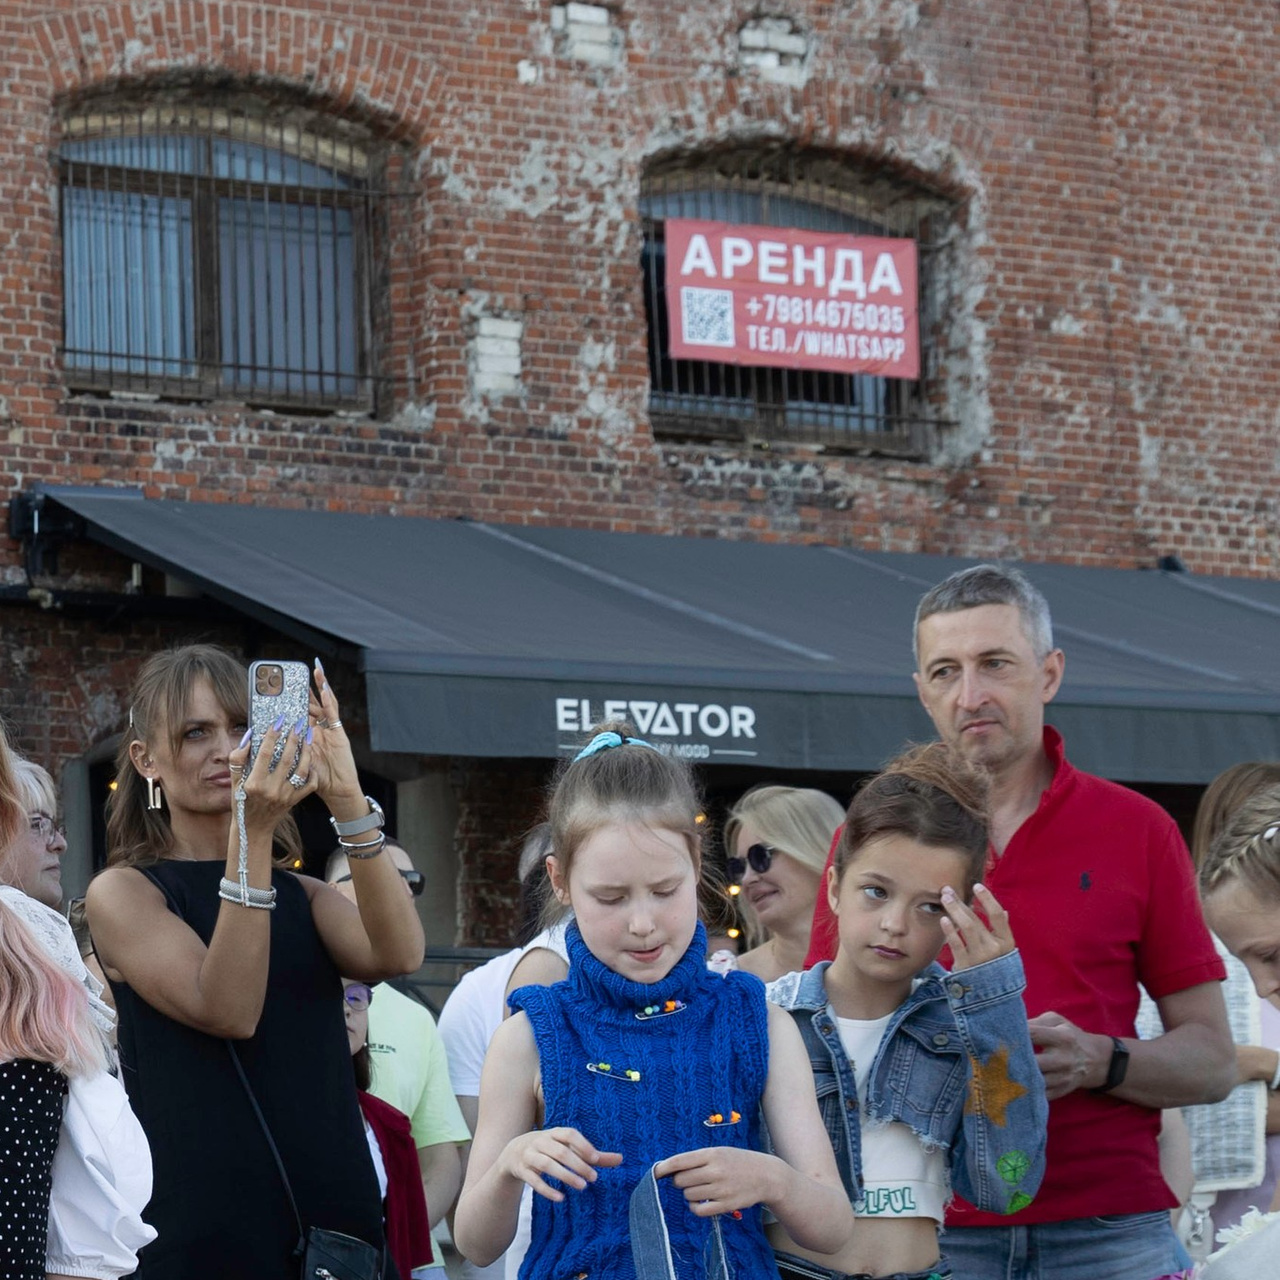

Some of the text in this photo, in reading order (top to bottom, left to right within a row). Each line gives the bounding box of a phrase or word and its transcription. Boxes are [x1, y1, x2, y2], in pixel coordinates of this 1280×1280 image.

[681, 234, 903, 300] АРЕНДА
[745, 294, 905, 333] +79814675035
[746, 325, 905, 363] ТЕЛ./WHATSAPP
[555, 698, 757, 738] ELEVATOR
